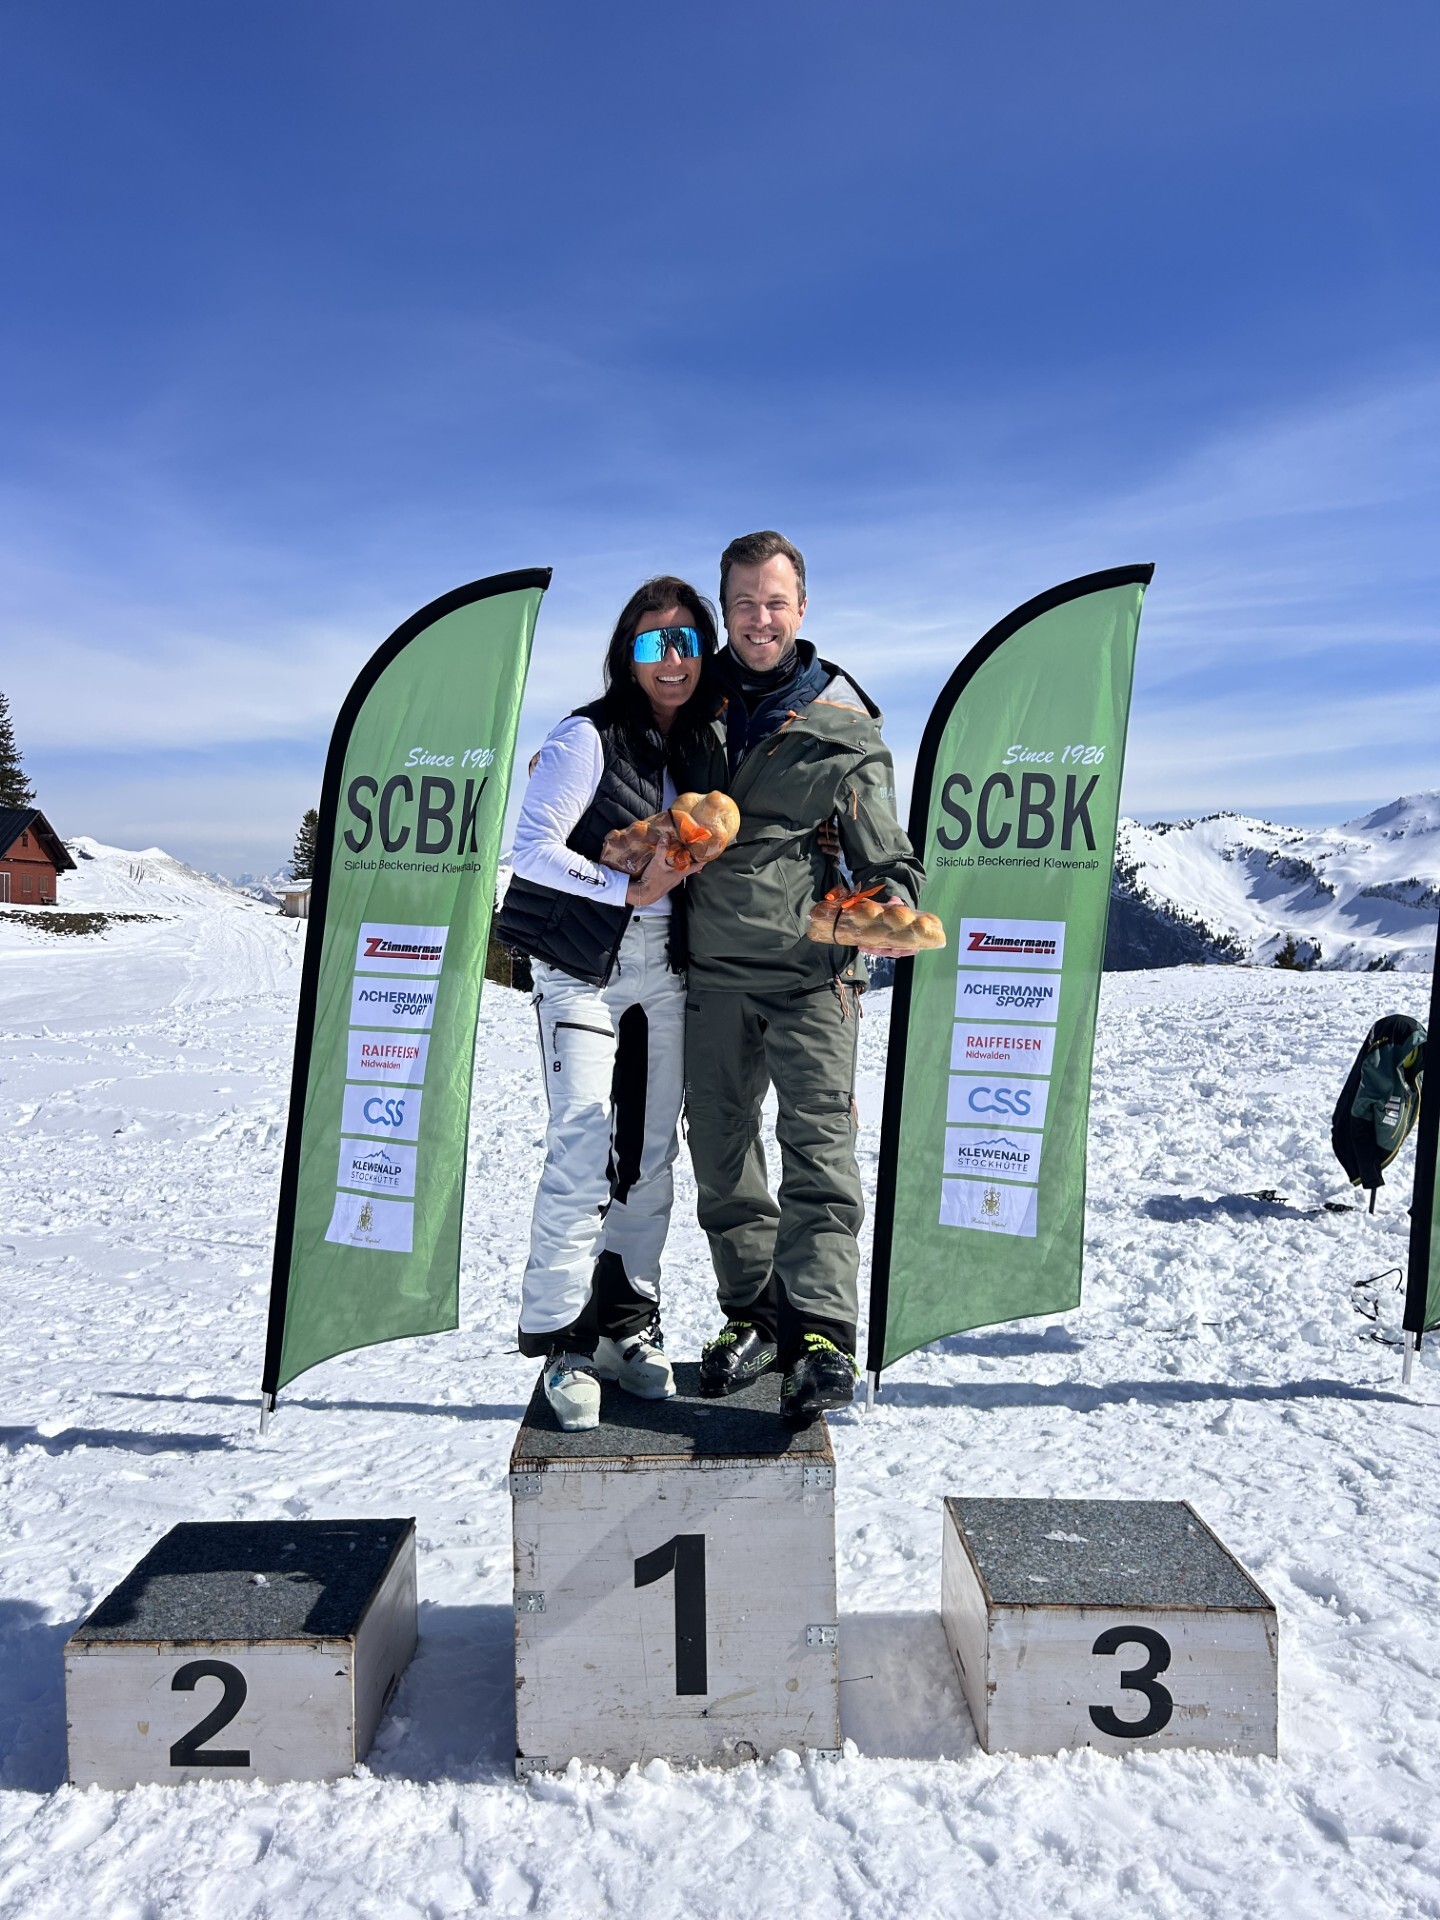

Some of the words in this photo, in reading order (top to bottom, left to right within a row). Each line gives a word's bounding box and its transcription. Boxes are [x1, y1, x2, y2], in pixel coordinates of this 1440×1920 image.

[405, 746, 455, 768] Since
[461, 747, 496, 768] 1926
[1002, 744, 1055, 765] Since
[1061, 744, 1106, 765] 1926
[344, 774, 489, 855] SCBK
[936, 771, 1101, 851] SCBK
[379, 859, 439, 873] Beckenried
[936, 856, 975, 868] Skiclub
[977, 856, 1040, 869] Beckenried
[1044, 858, 1099, 871] Klewenalp
[568, 868, 606, 887] HEAD
[983, 935, 1056, 948] Zimmermann
[359, 990, 434, 1005] ACHERMANN
[963, 984, 1053, 998] ACHERMANN
[392, 1003, 428, 1015] SPORT
[996, 996, 1045, 1009] SPORT
[966, 1036, 1042, 1051] RAIFFEISEN
[361, 1044, 420, 1059] RAIFFEISEN
[966, 1050, 1010, 1061] Nidwalden
[360, 1059, 401, 1070] Nidwalden
[968, 1086, 1032, 1116] CSS
[363, 1097, 406, 1127] CSS
[958, 1146, 1031, 1163] KLEWENALP
[352, 1159, 402, 1175] KLEWENALP
[957, 1157, 1029, 1172] STOCKHÜTTE
[633, 1533, 707, 1696] 1
[1088, 1625, 1173, 1739] 3
[169, 1659, 251, 1767] 2
